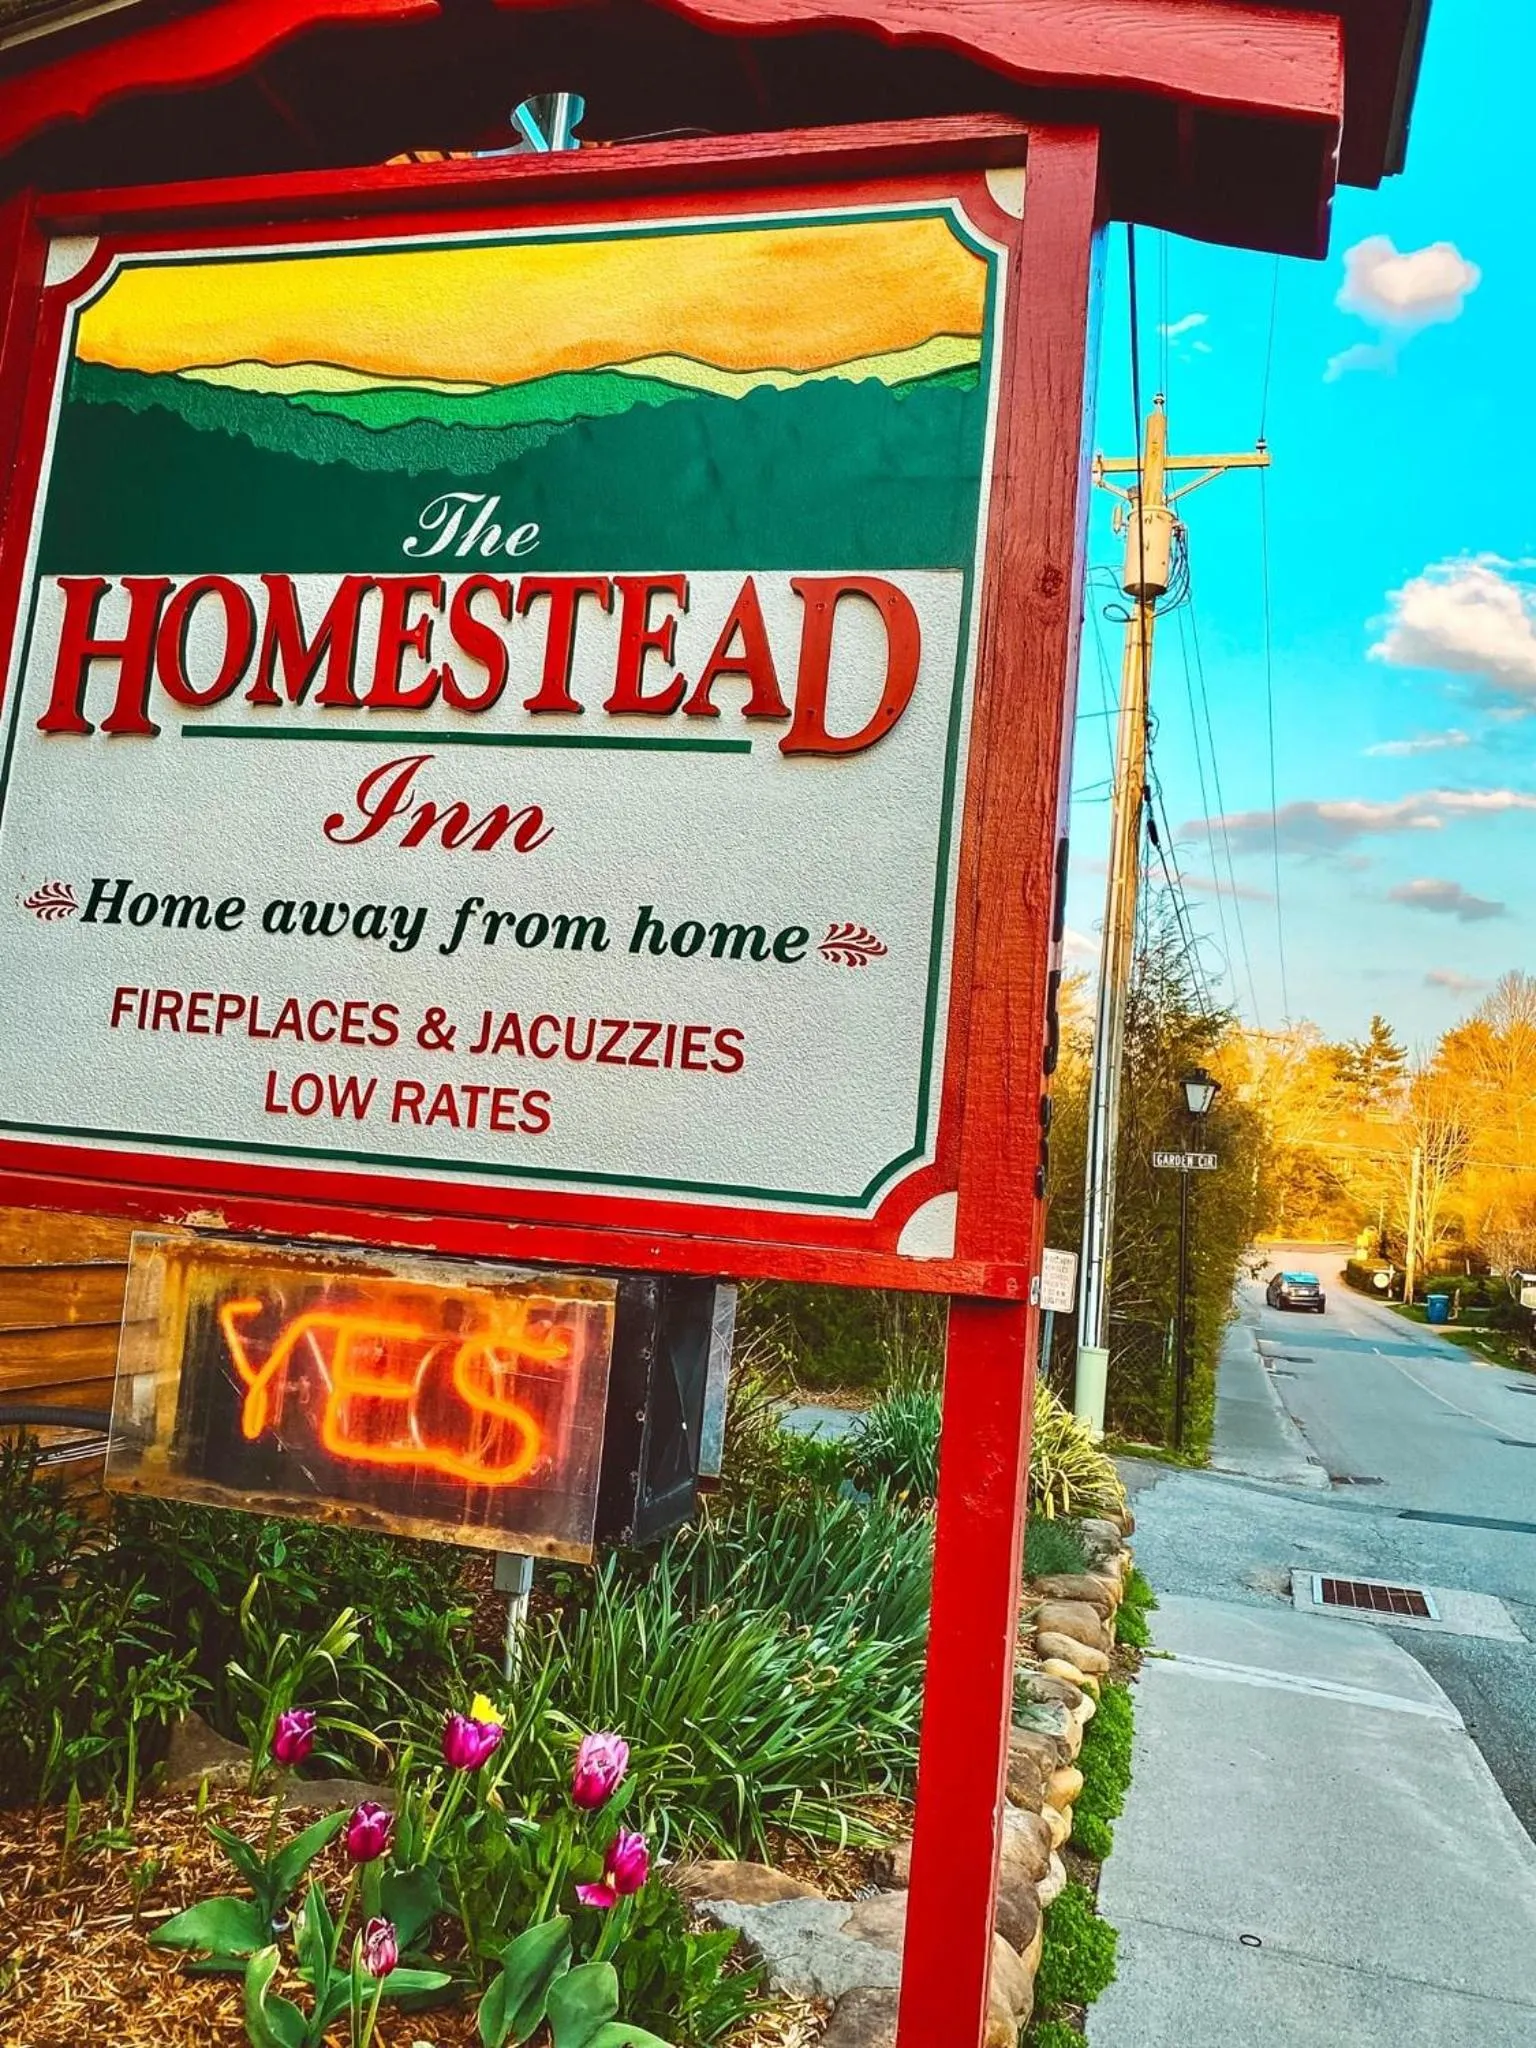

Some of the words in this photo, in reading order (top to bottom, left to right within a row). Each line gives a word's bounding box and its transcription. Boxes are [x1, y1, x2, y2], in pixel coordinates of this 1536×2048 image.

[403, 491, 540, 558] The
[36, 572, 922, 757] HOMESTEAD
[323, 754, 555, 853] Inn
[80, 878, 246, 932] Home
[262, 899, 428, 956] away
[439, 897, 610, 956] from
[630, 905, 810, 963] home
[110, 986, 401, 1048] FIREPLACES
[416, 1006, 456, 1052] &
[470, 1010, 746, 1074] JACUZZIES
[264, 1070, 378, 1120] LOW
[391, 1079, 552, 1134] RATES
[1157, 1154, 1193, 1167] GARDEN
[219, 1299, 570, 1486] YES
